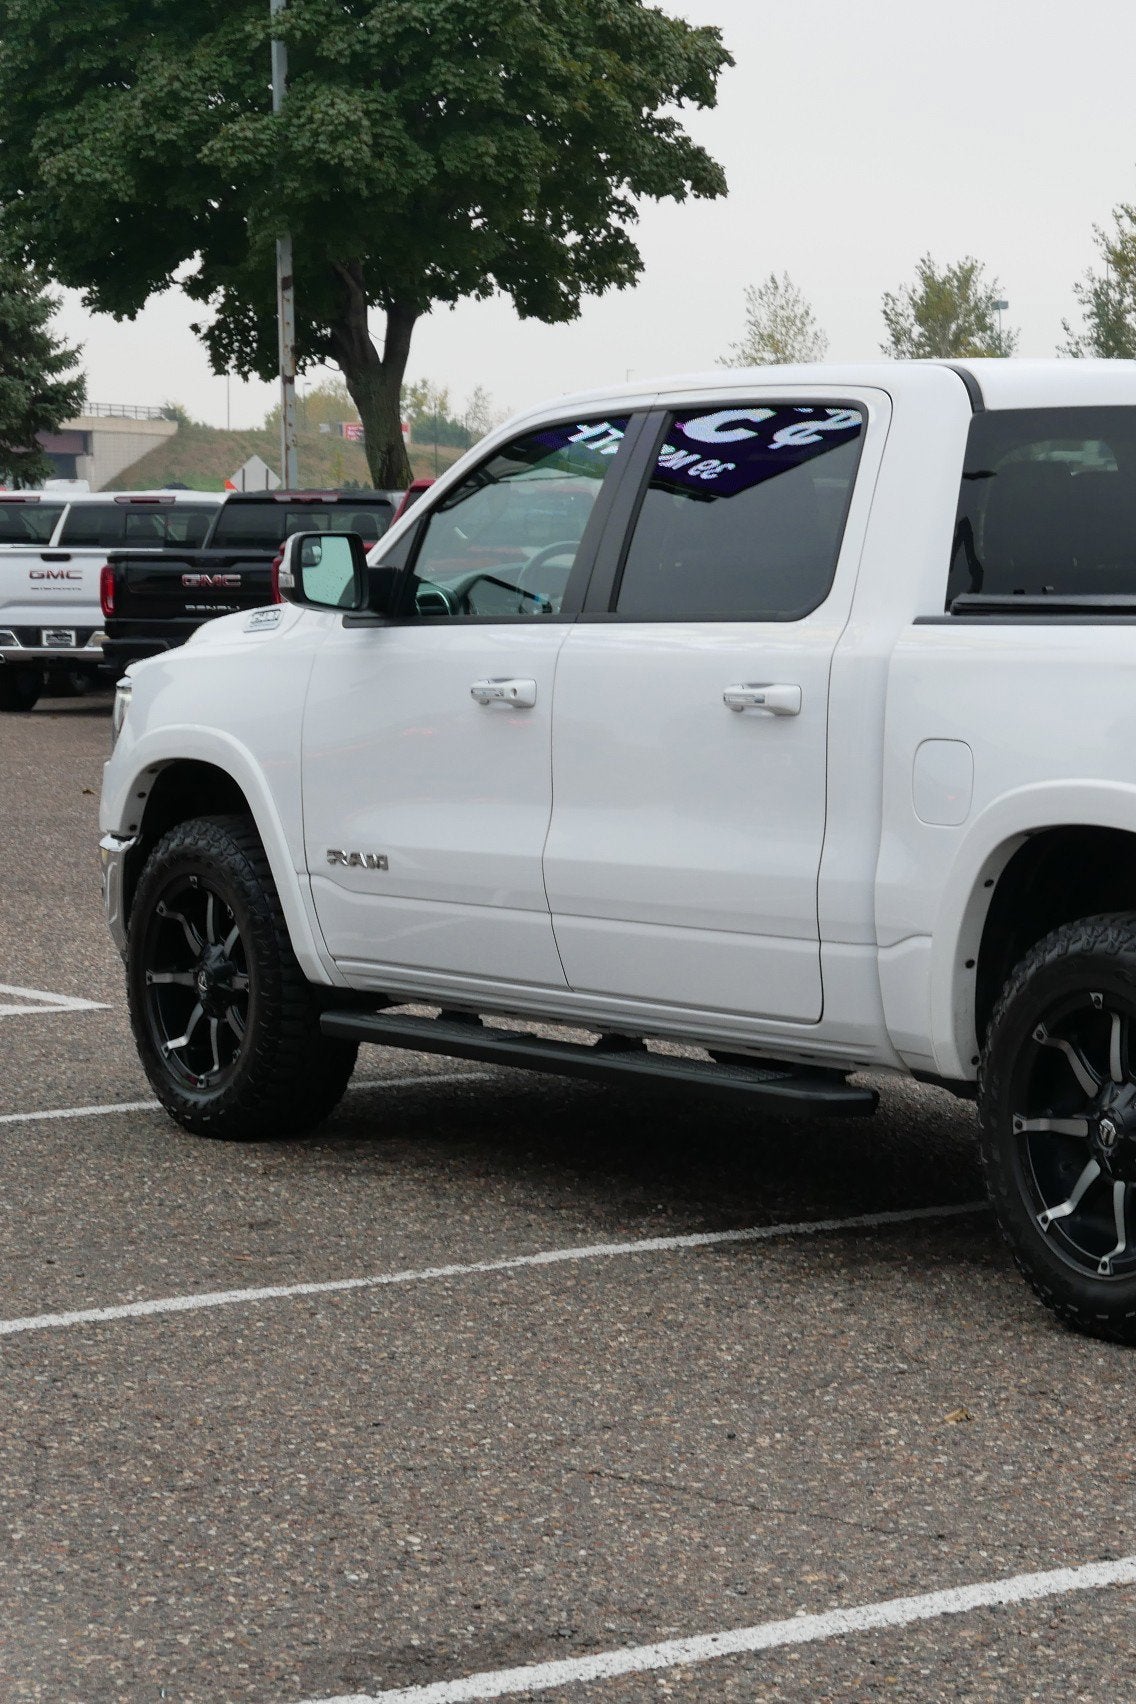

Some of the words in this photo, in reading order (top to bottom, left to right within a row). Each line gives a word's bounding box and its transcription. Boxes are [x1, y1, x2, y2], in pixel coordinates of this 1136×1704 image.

[28, 569, 83, 580] GMC
[181, 573, 242, 588] GMC
[326, 849, 389, 871] RAM
